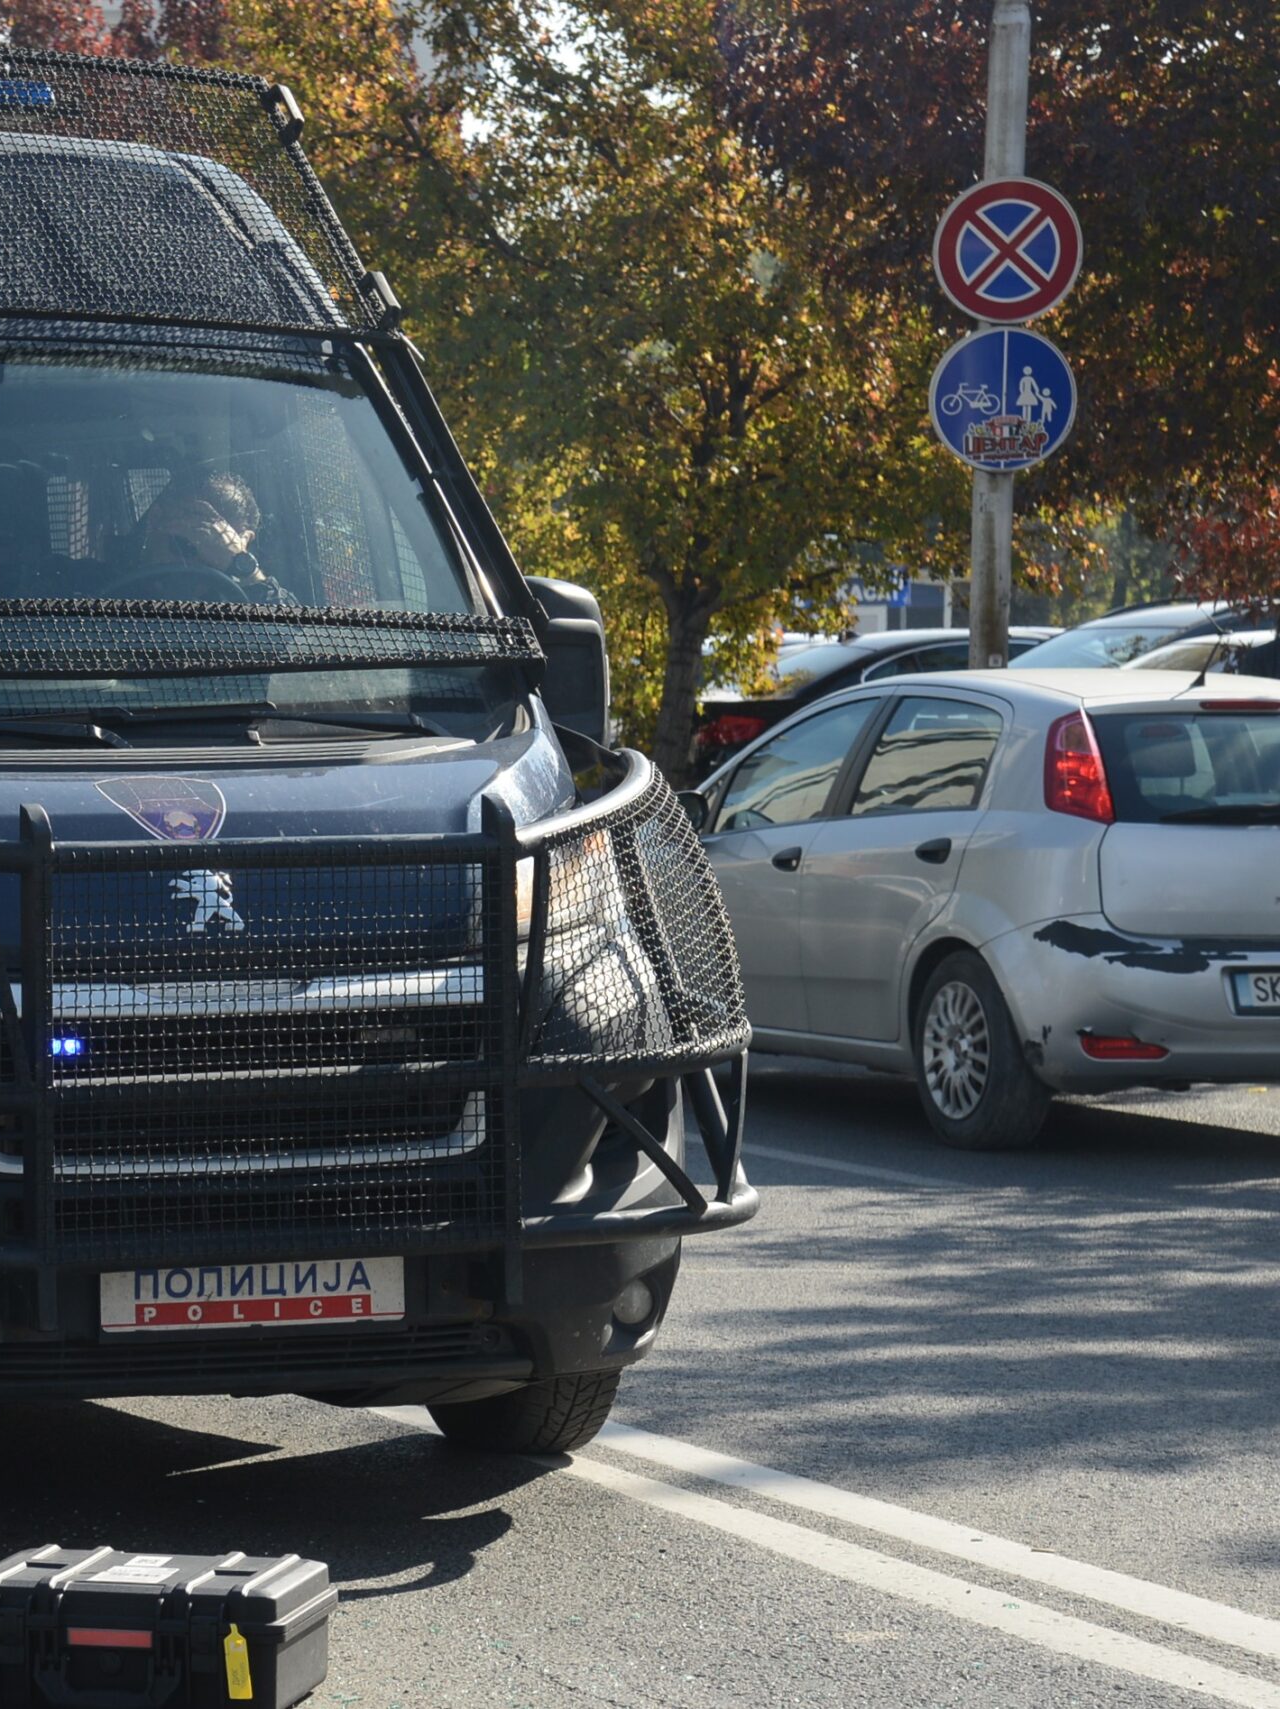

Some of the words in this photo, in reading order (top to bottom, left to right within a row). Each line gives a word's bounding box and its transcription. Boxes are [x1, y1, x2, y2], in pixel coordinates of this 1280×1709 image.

[1254, 976, 1280, 1003] SK
[134, 1260, 371, 1300] ПОЛИЦИЈА
[143, 1297, 364, 1323] POLICE
